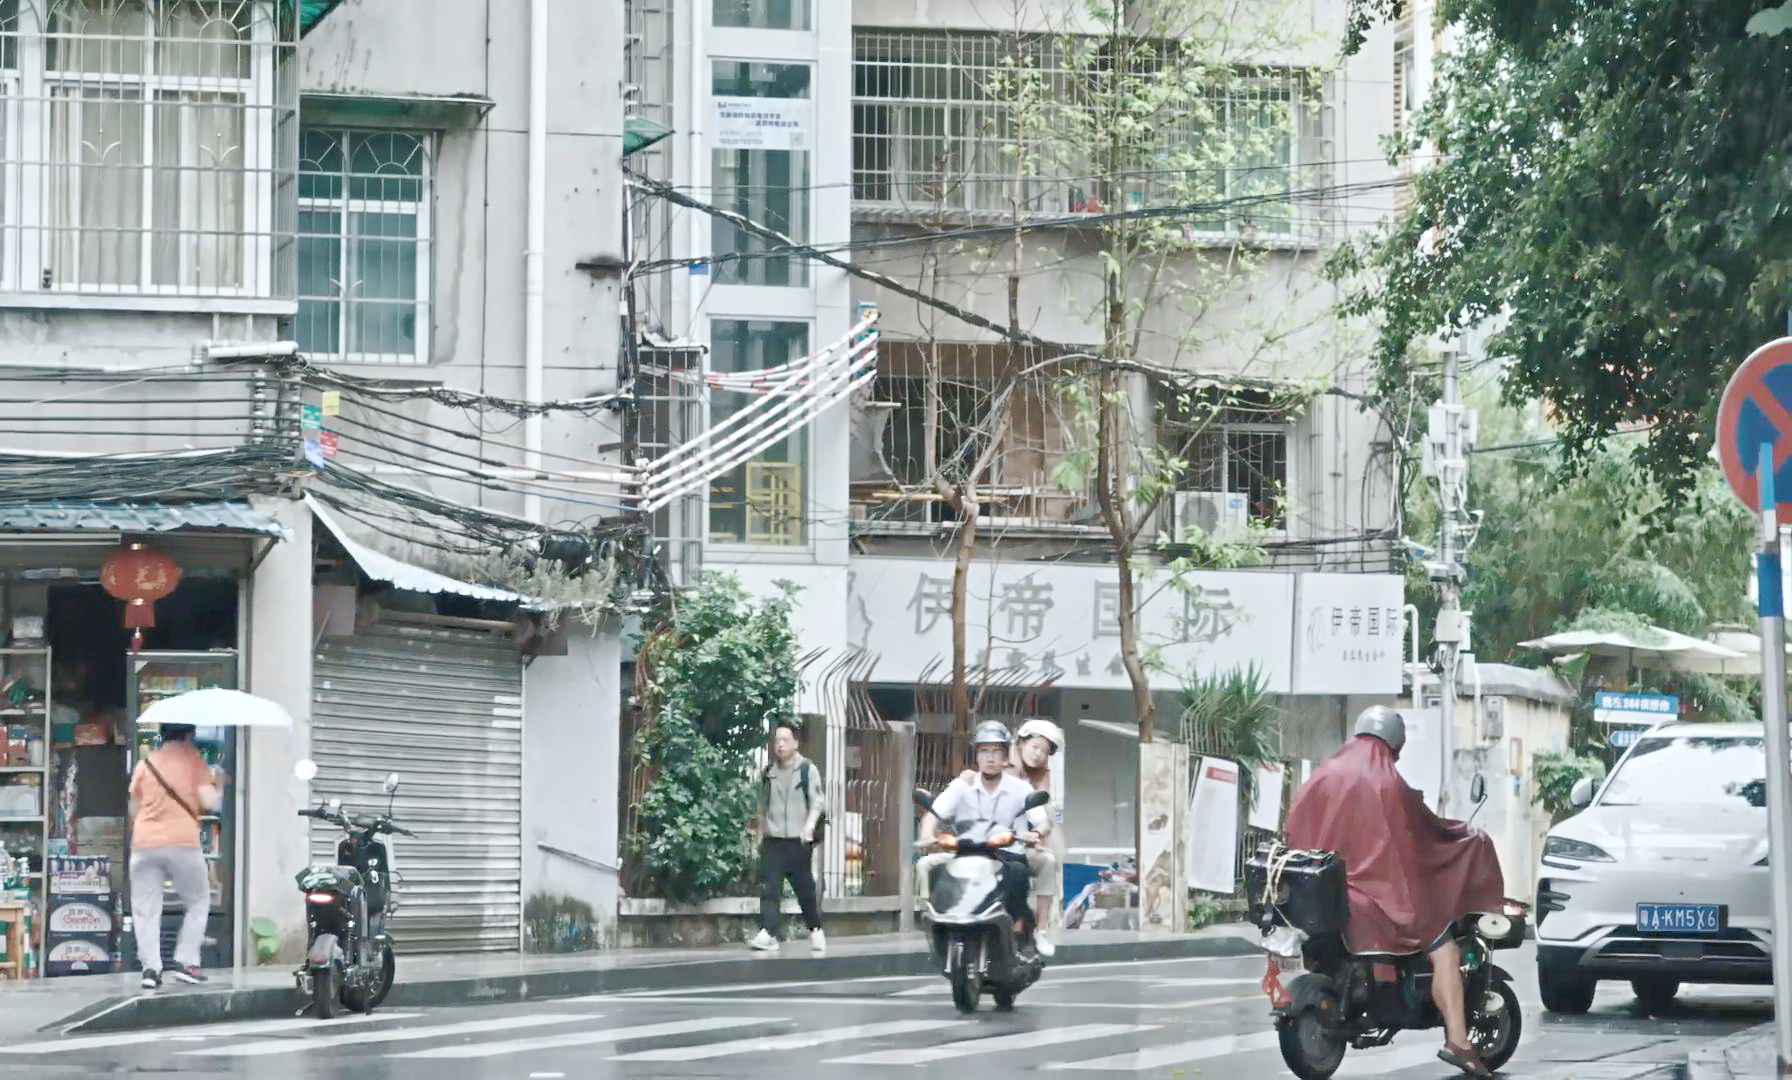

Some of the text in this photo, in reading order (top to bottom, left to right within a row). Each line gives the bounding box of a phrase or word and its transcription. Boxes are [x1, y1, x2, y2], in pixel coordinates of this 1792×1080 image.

[906, 571, 1236, 643] 伊帝国际
[1331, 606, 1398, 637] 伊帝国际
